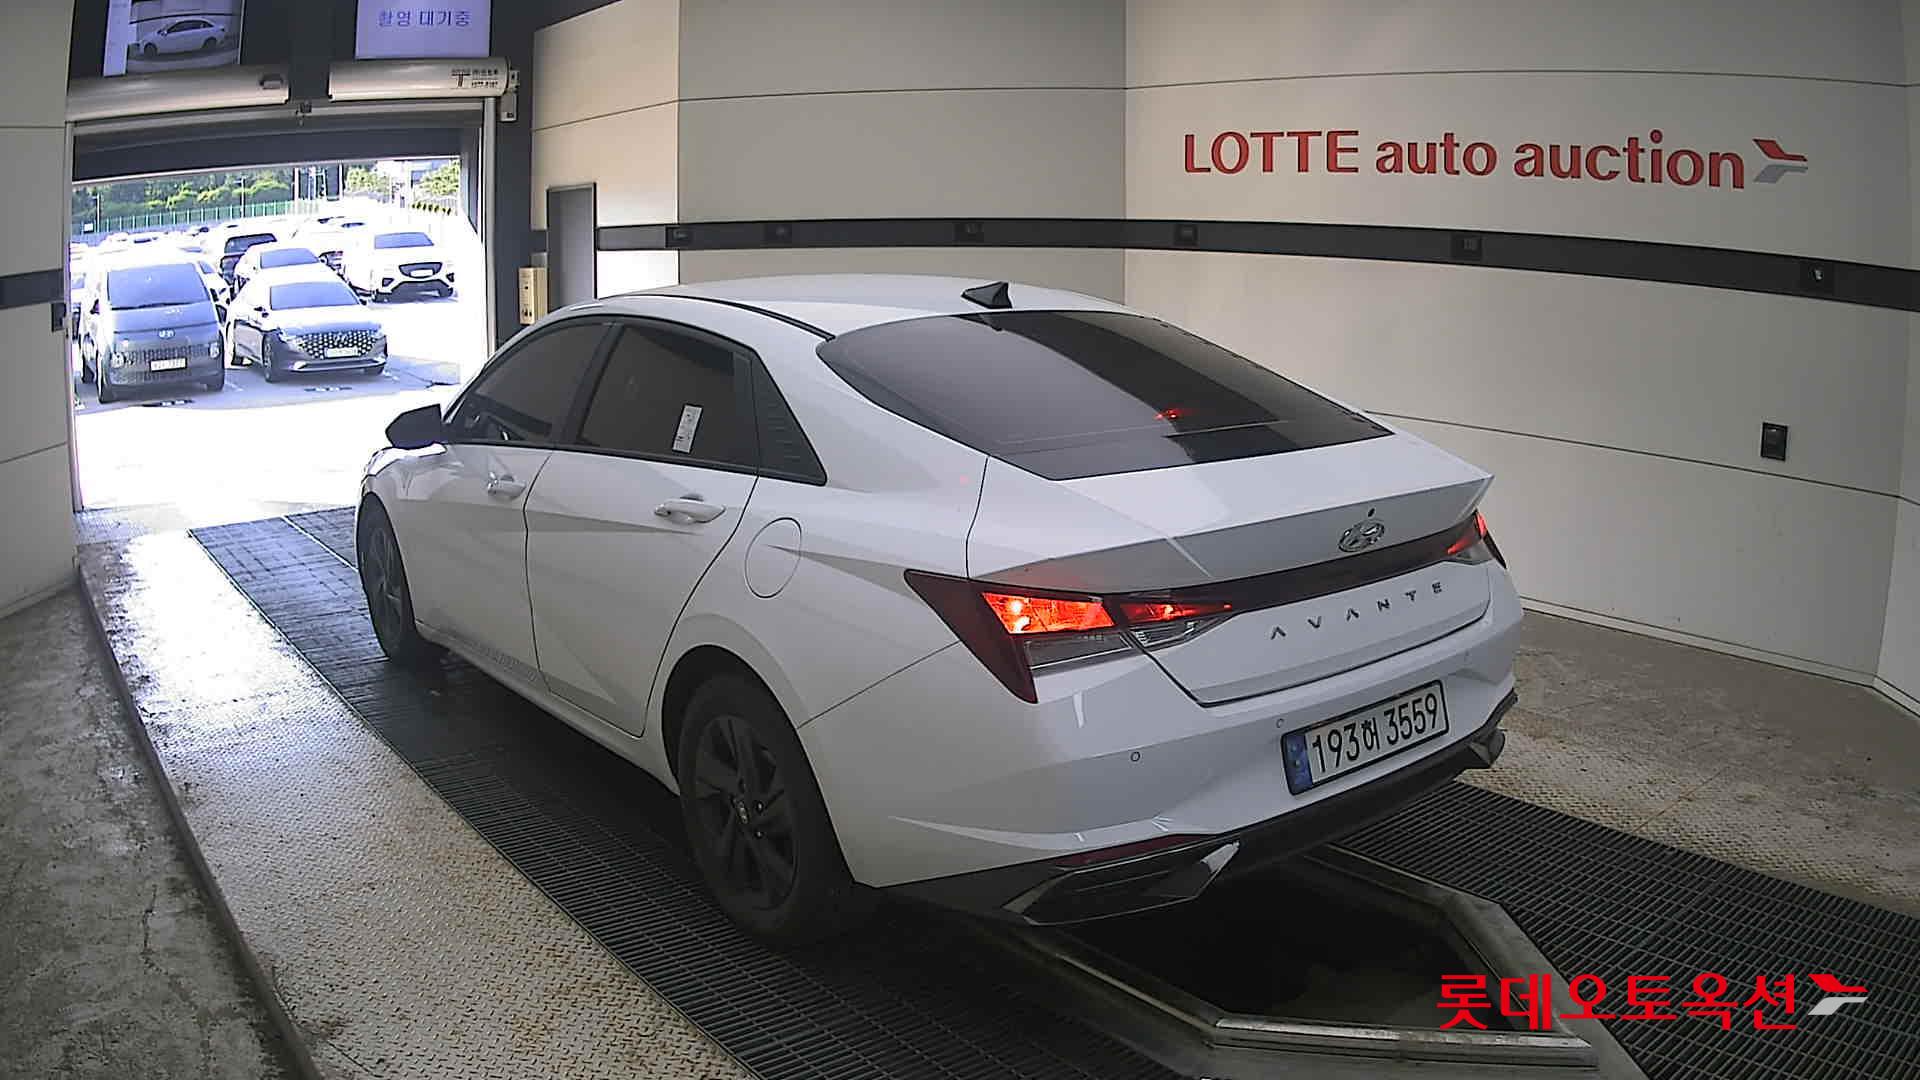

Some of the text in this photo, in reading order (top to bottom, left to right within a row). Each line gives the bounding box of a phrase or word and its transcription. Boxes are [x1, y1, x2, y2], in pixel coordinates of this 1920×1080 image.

[419, 9, 471, 27] 대기중
[1183, 129, 1745, 189] LOTTE auto auction
[1269, 580, 1443, 640] AVANTE
[1311, 692, 1439, 774] 193허 3559
